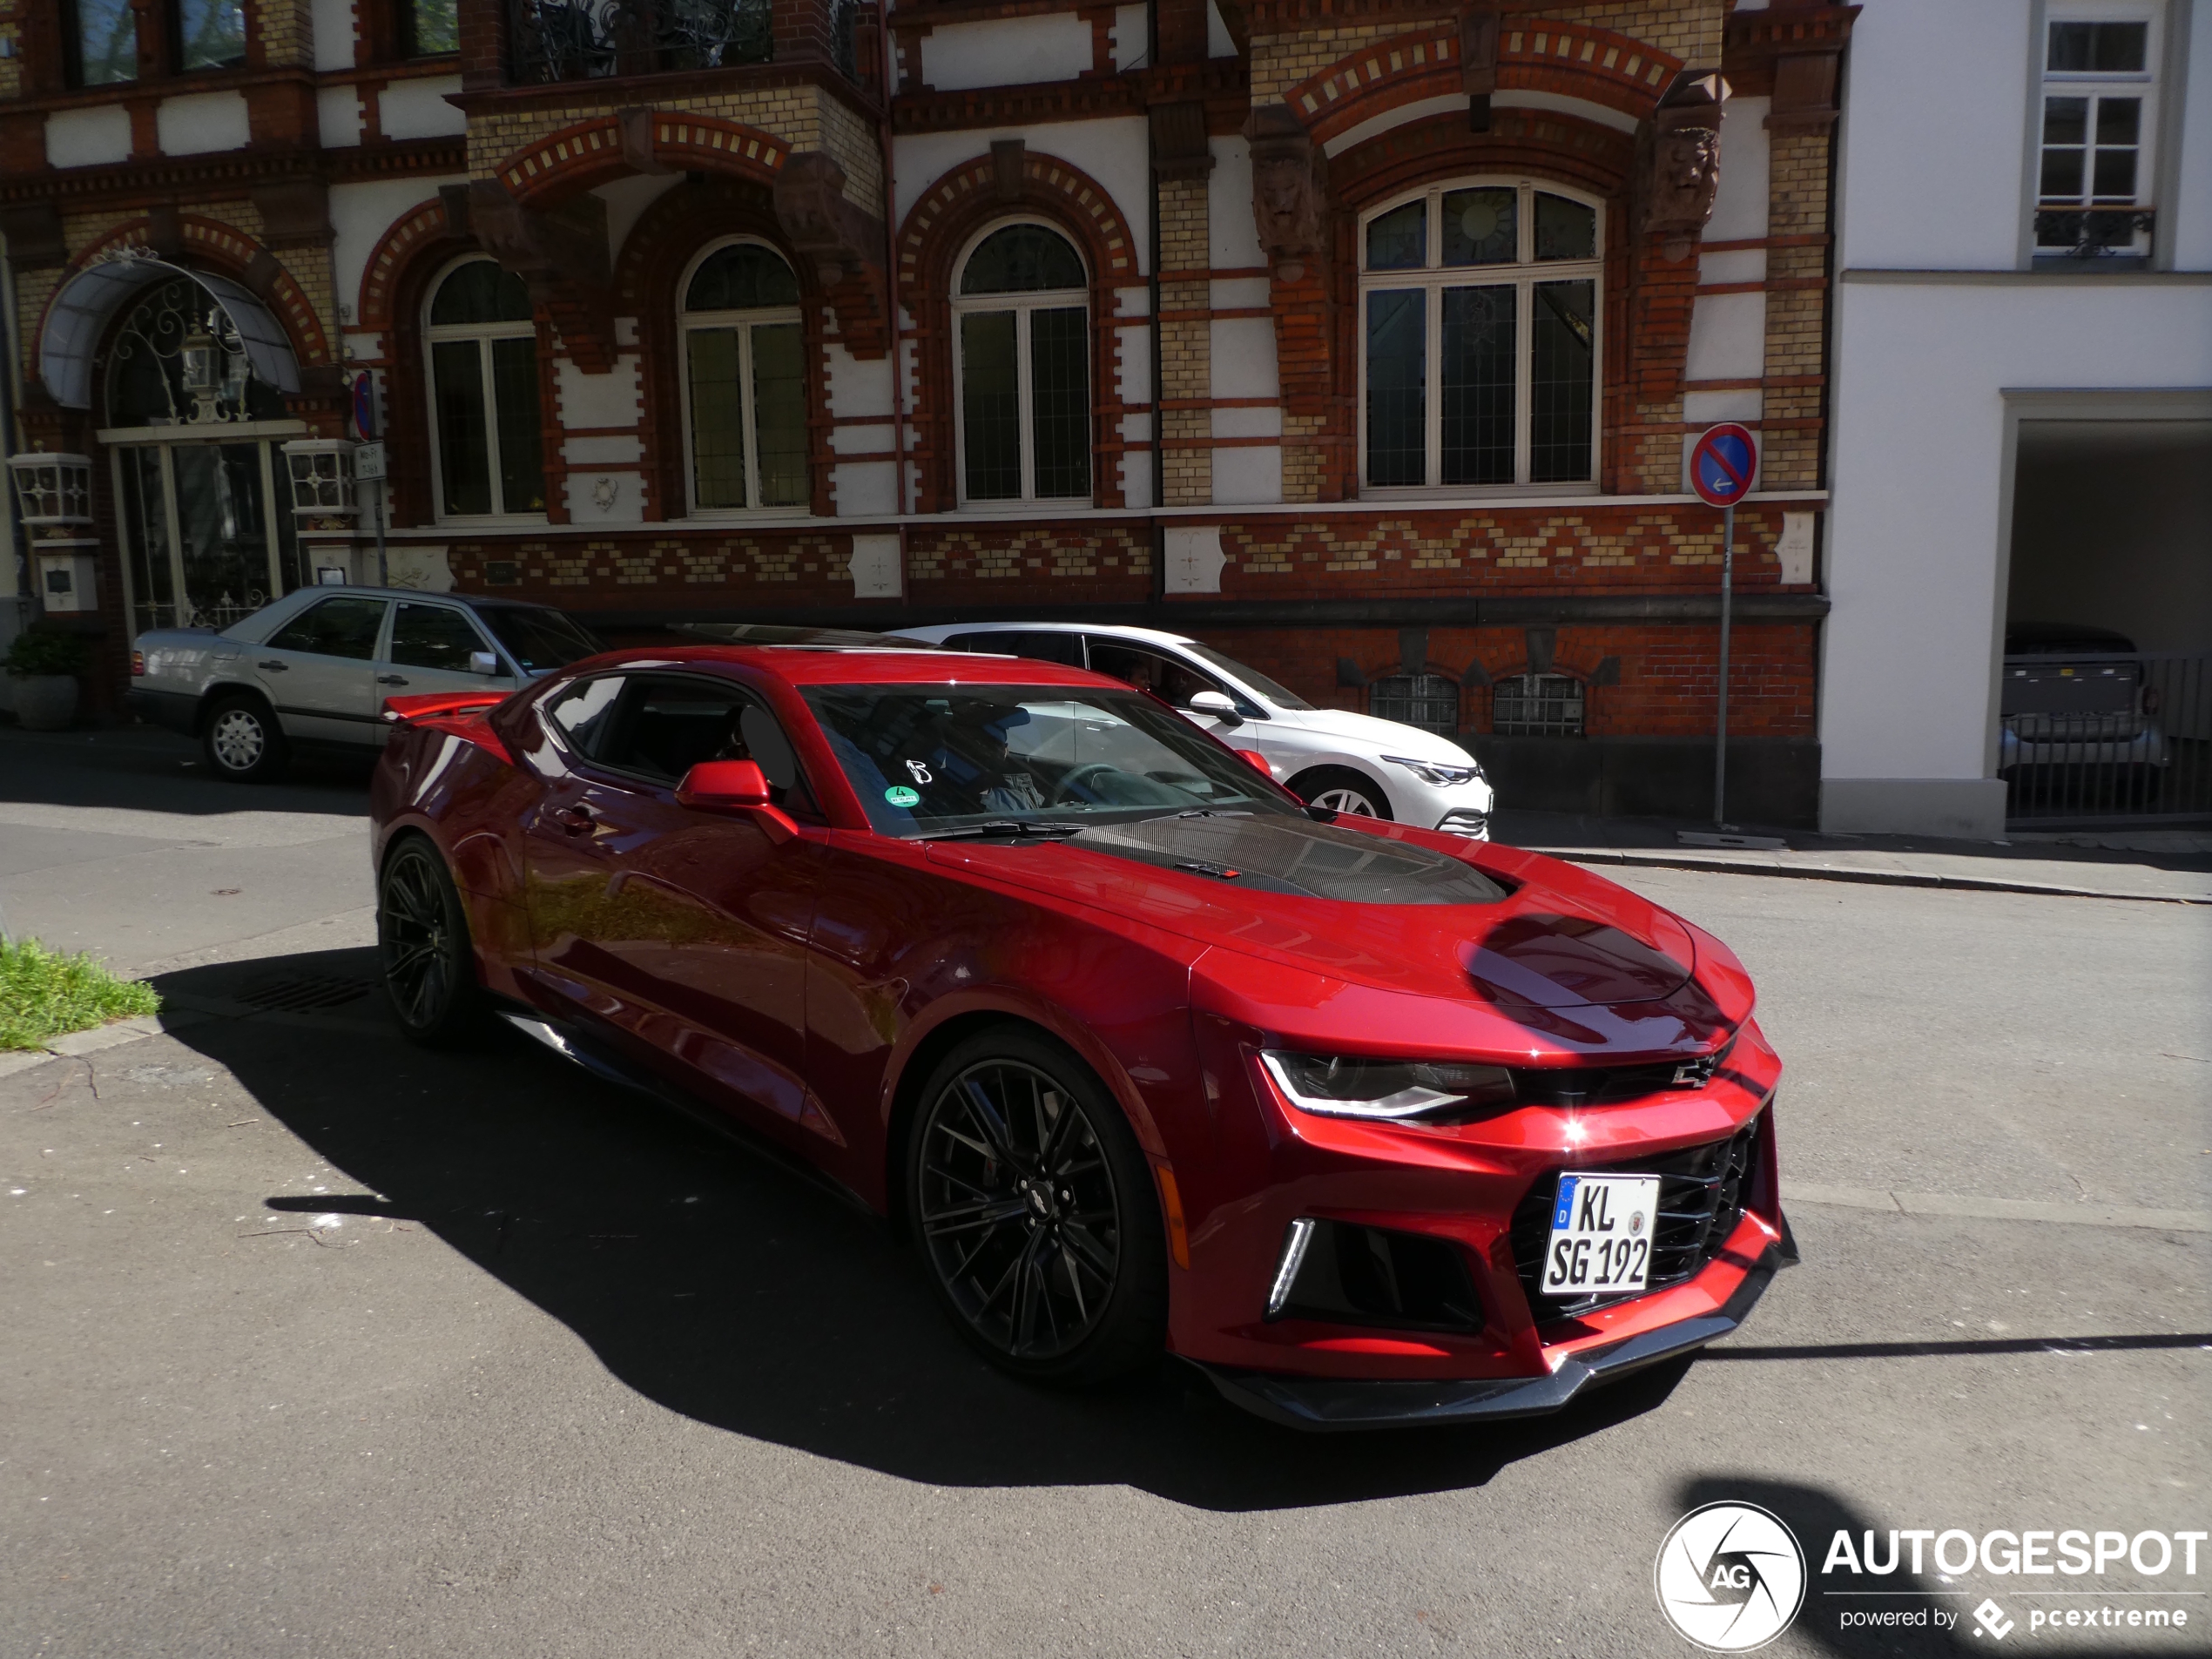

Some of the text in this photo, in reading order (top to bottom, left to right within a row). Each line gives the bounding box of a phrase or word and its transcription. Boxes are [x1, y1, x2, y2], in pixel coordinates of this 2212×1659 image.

[896, 787, 906, 796] 4
[1558, 1210, 1567, 1224] D
[1579, 1185, 1615, 1231] KL
[1549, 1238, 1648, 1286] SG 192
